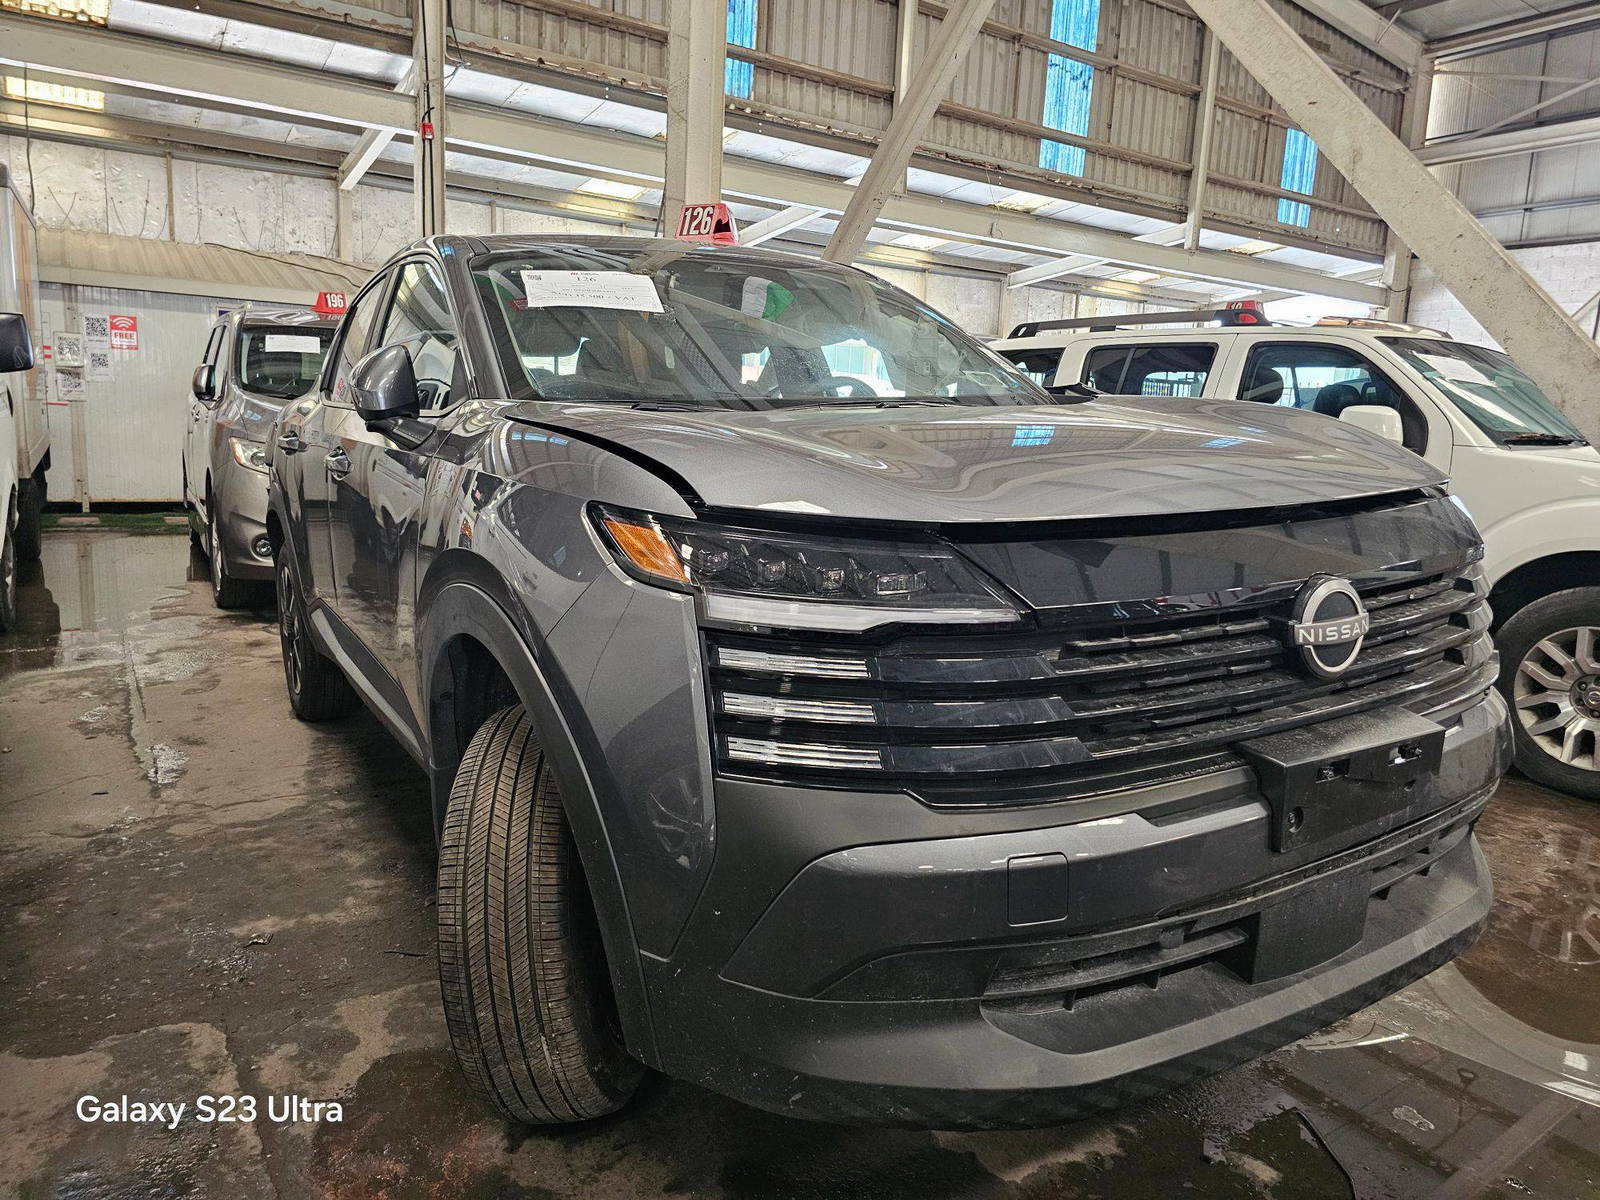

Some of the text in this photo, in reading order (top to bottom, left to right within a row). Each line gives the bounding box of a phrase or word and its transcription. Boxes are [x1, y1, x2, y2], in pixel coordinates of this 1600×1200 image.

[682, 206, 714, 235] 126
[325, 293, 344, 308] 196
[114, 332, 135, 340] FREE
[1298, 618, 1369, 643] NISSAN
